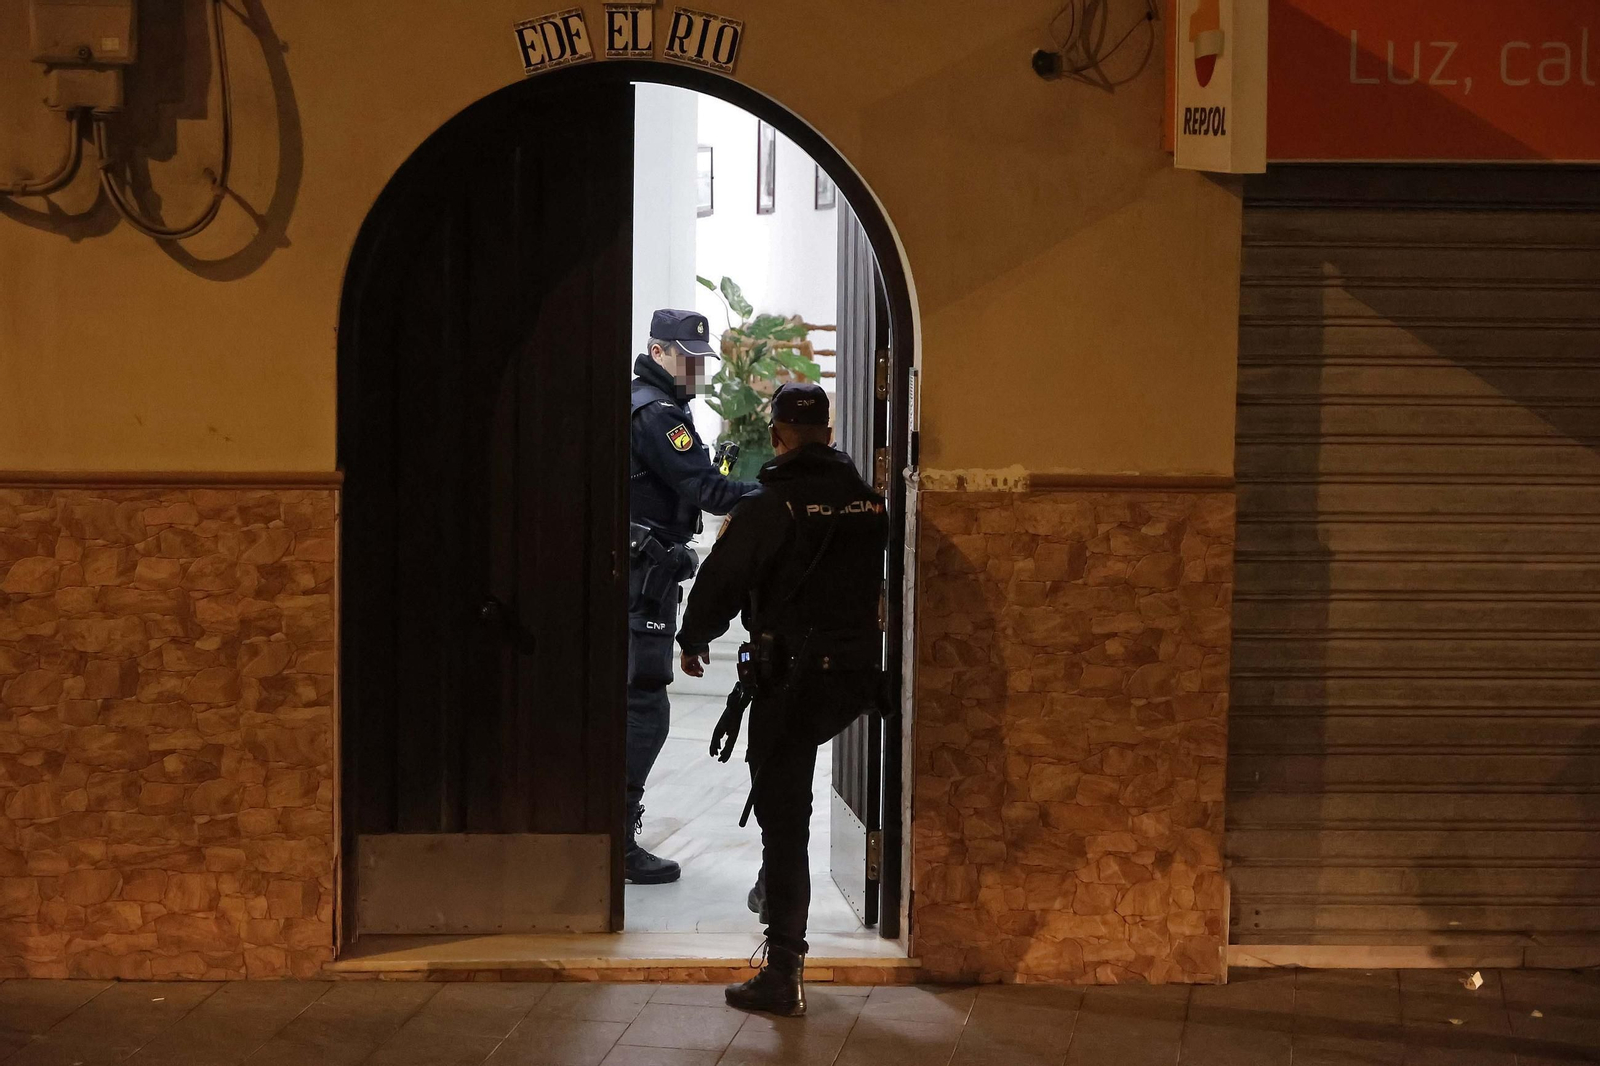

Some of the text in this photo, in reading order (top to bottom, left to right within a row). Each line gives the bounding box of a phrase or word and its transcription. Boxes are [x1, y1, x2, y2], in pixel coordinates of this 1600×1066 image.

[515, 10, 739, 68] EDF EL RIO
[1349, 27, 1596, 95] Luz, cal
[1183, 106, 1226, 136] REPSOL
[646, 621, 666, 630] CNP
